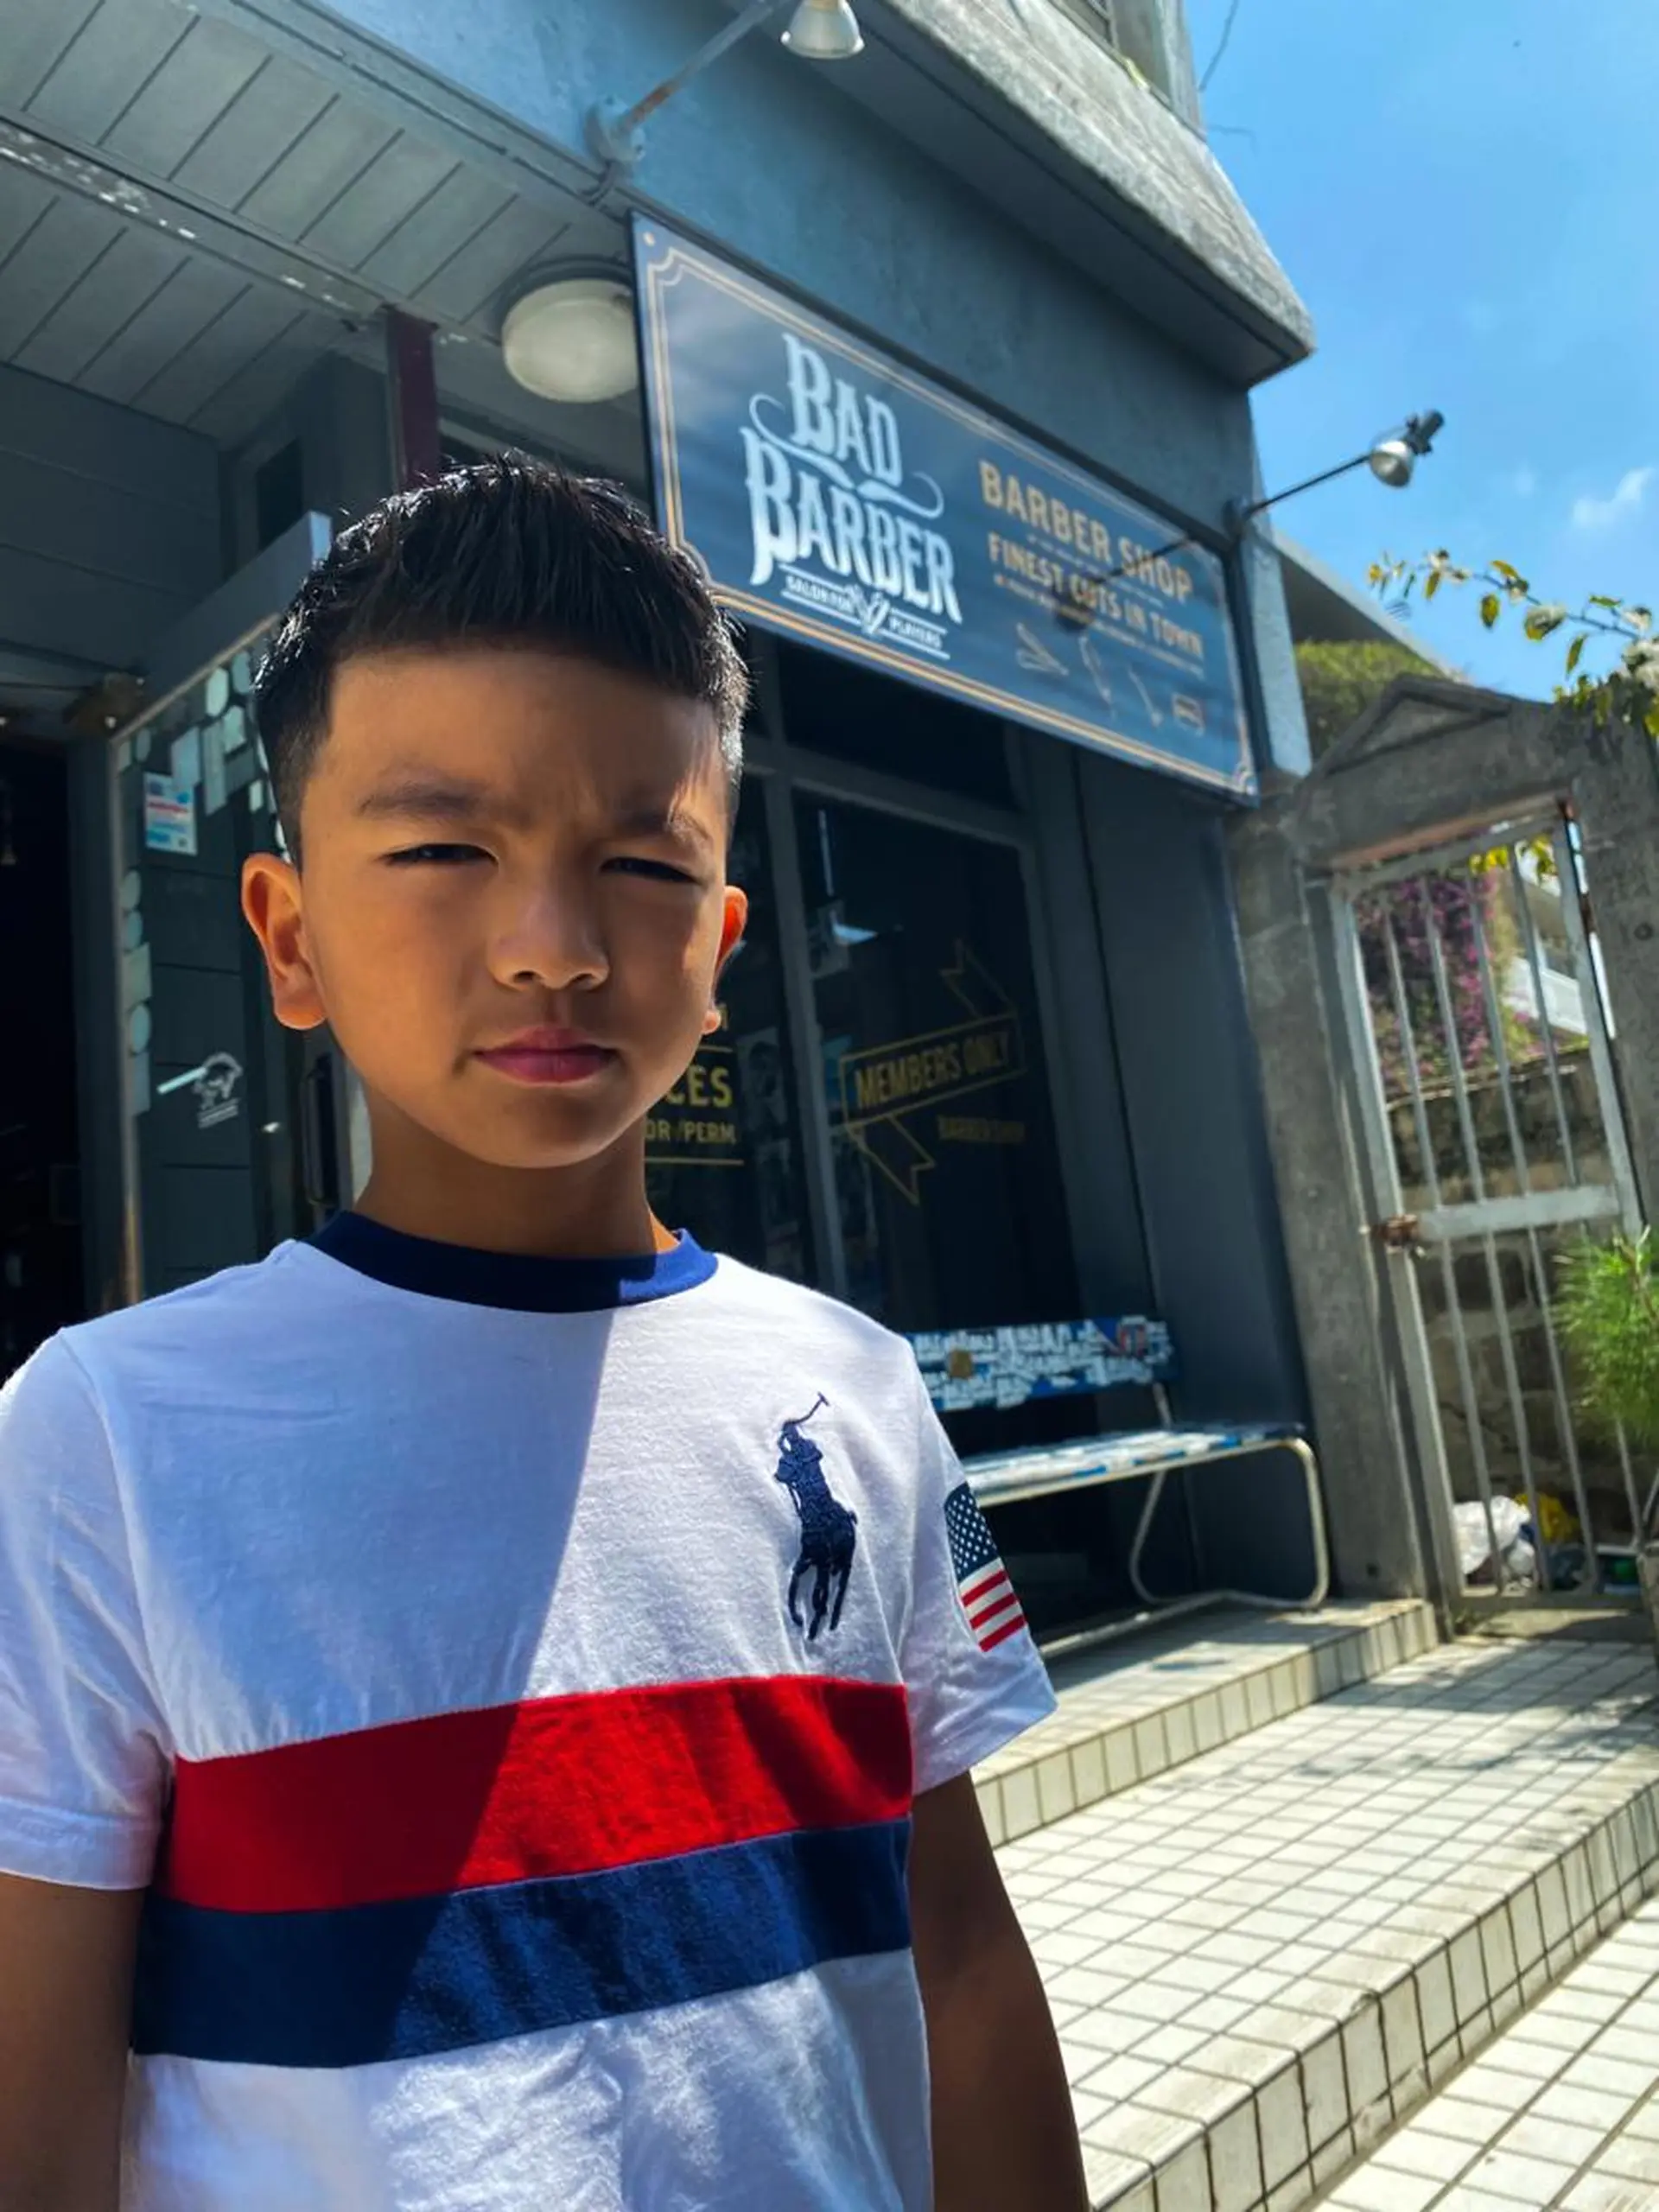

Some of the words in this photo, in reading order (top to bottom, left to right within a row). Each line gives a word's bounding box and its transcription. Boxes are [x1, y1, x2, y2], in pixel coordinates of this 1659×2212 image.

[783, 332, 902, 488] BAD
[741, 427, 963, 624] BARBER
[979, 460, 1113, 565] BARBER
[1118, 537, 1193, 603] SHOP
[988, 531, 1064, 593] FINEST
[1069, 574, 1122, 620] CUTS
[1124, 600, 1147, 634] IN
[1149, 611, 1205, 662] TOWN
[854, 1042, 963, 1110] MEMBERS
